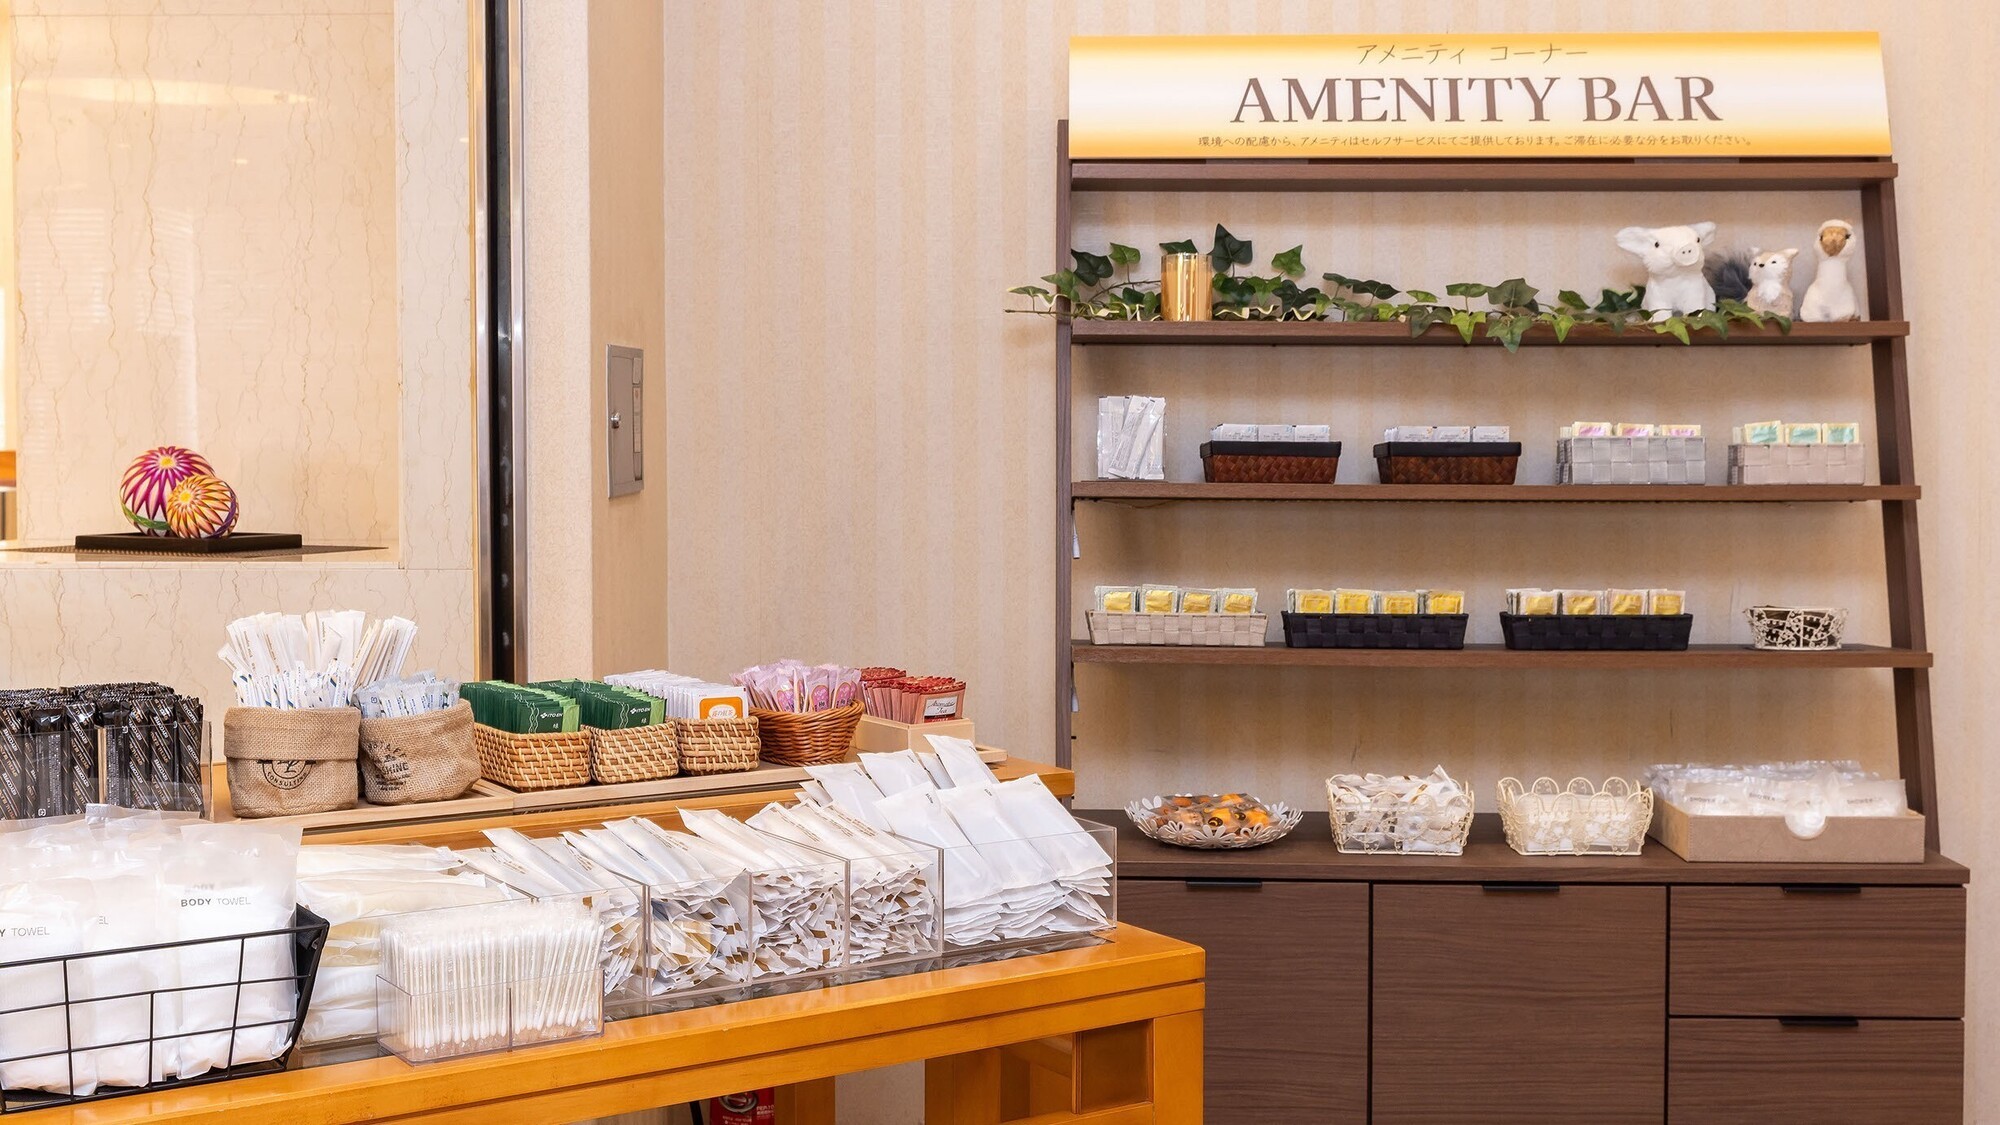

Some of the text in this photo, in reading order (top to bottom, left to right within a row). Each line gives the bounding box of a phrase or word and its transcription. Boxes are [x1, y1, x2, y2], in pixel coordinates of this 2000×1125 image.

[1357, 43, 1588, 64] アメニティ コーナー
[1229, 76, 1723, 123] AMENITY BAR
[181, 896, 252, 907] BODY TOWEL
[11, 926, 50, 937] TOWEL
